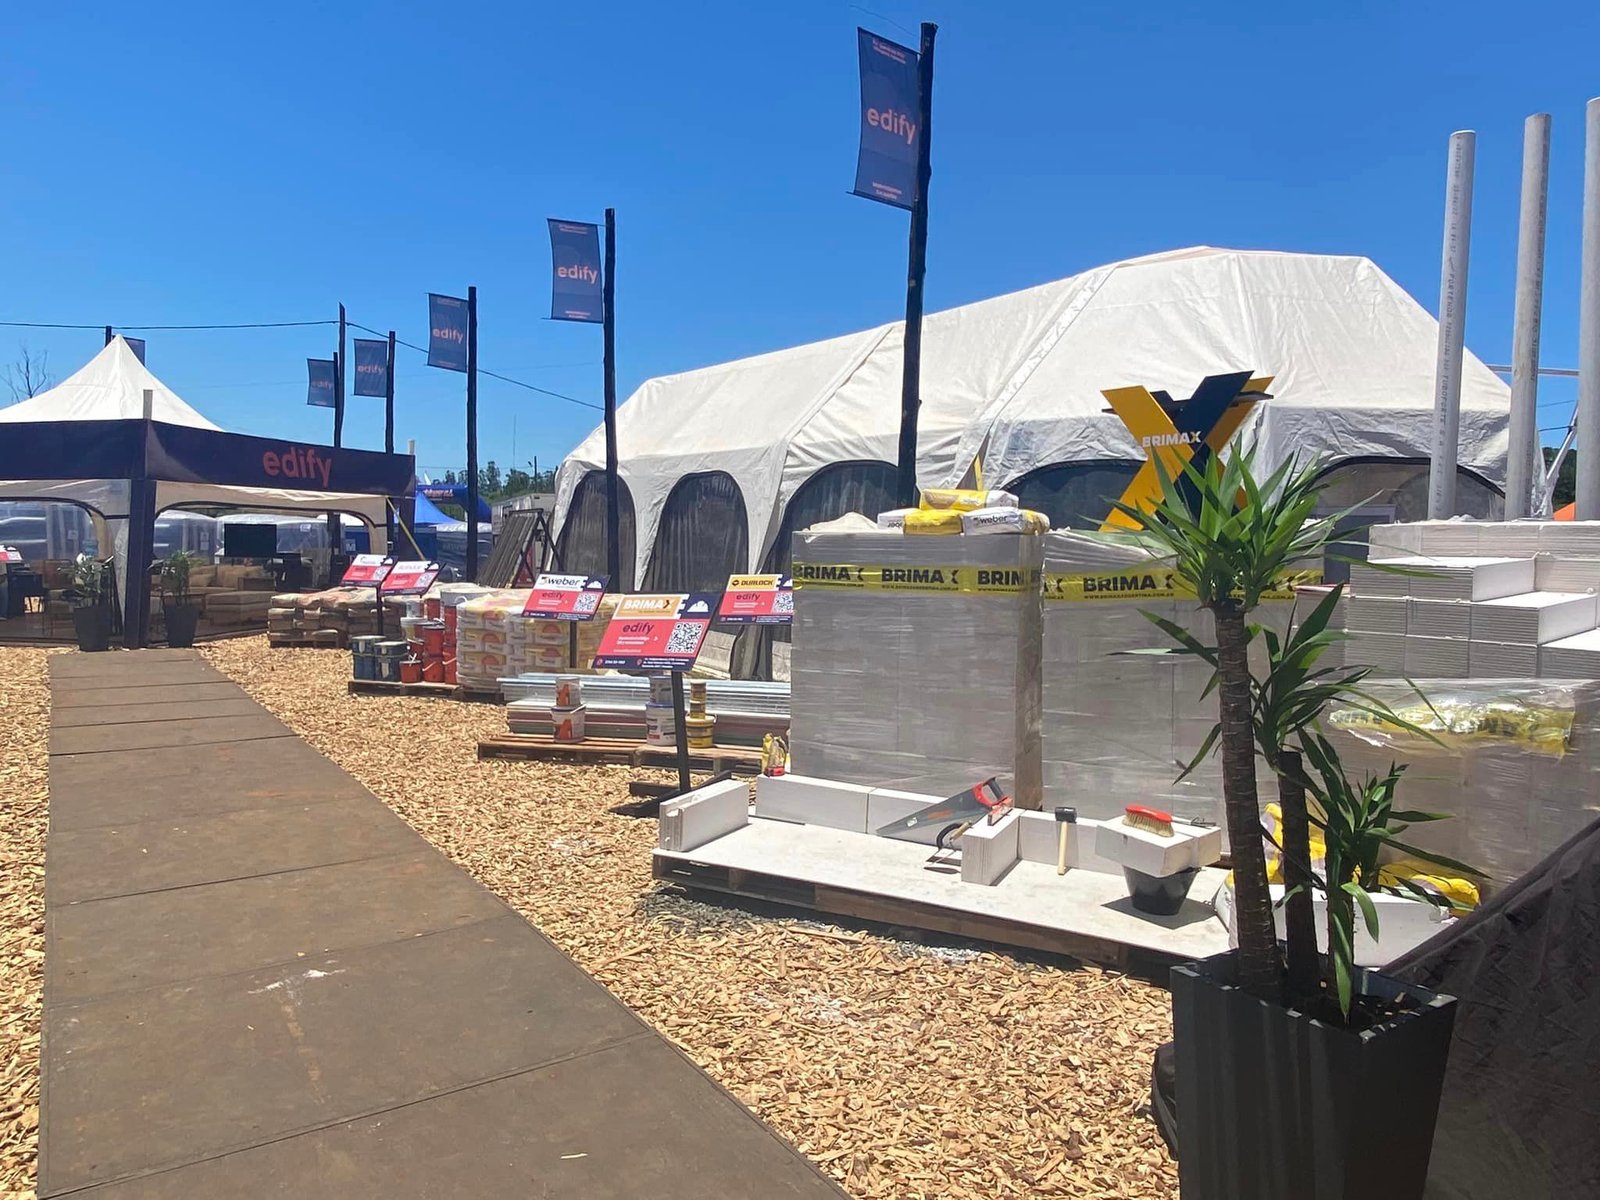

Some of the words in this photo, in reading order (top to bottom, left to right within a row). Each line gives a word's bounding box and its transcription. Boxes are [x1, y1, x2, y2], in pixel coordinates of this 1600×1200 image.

[867, 108, 916, 144] edify
[557, 265, 598, 284] edify
[432, 326, 464, 344] edify
[357, 363, 385, 376] edify
[1142, 430, 1202, 448] BRIMAX
[263, 446, 332, 488] edify
[980, 514, 1008, 524] weber
[547, 577, 581, 587] weber
[736, 592, 761, 602] edify
[623, 599, 675, 610] BRIMAX
[622, 621, 655, 635] edify
